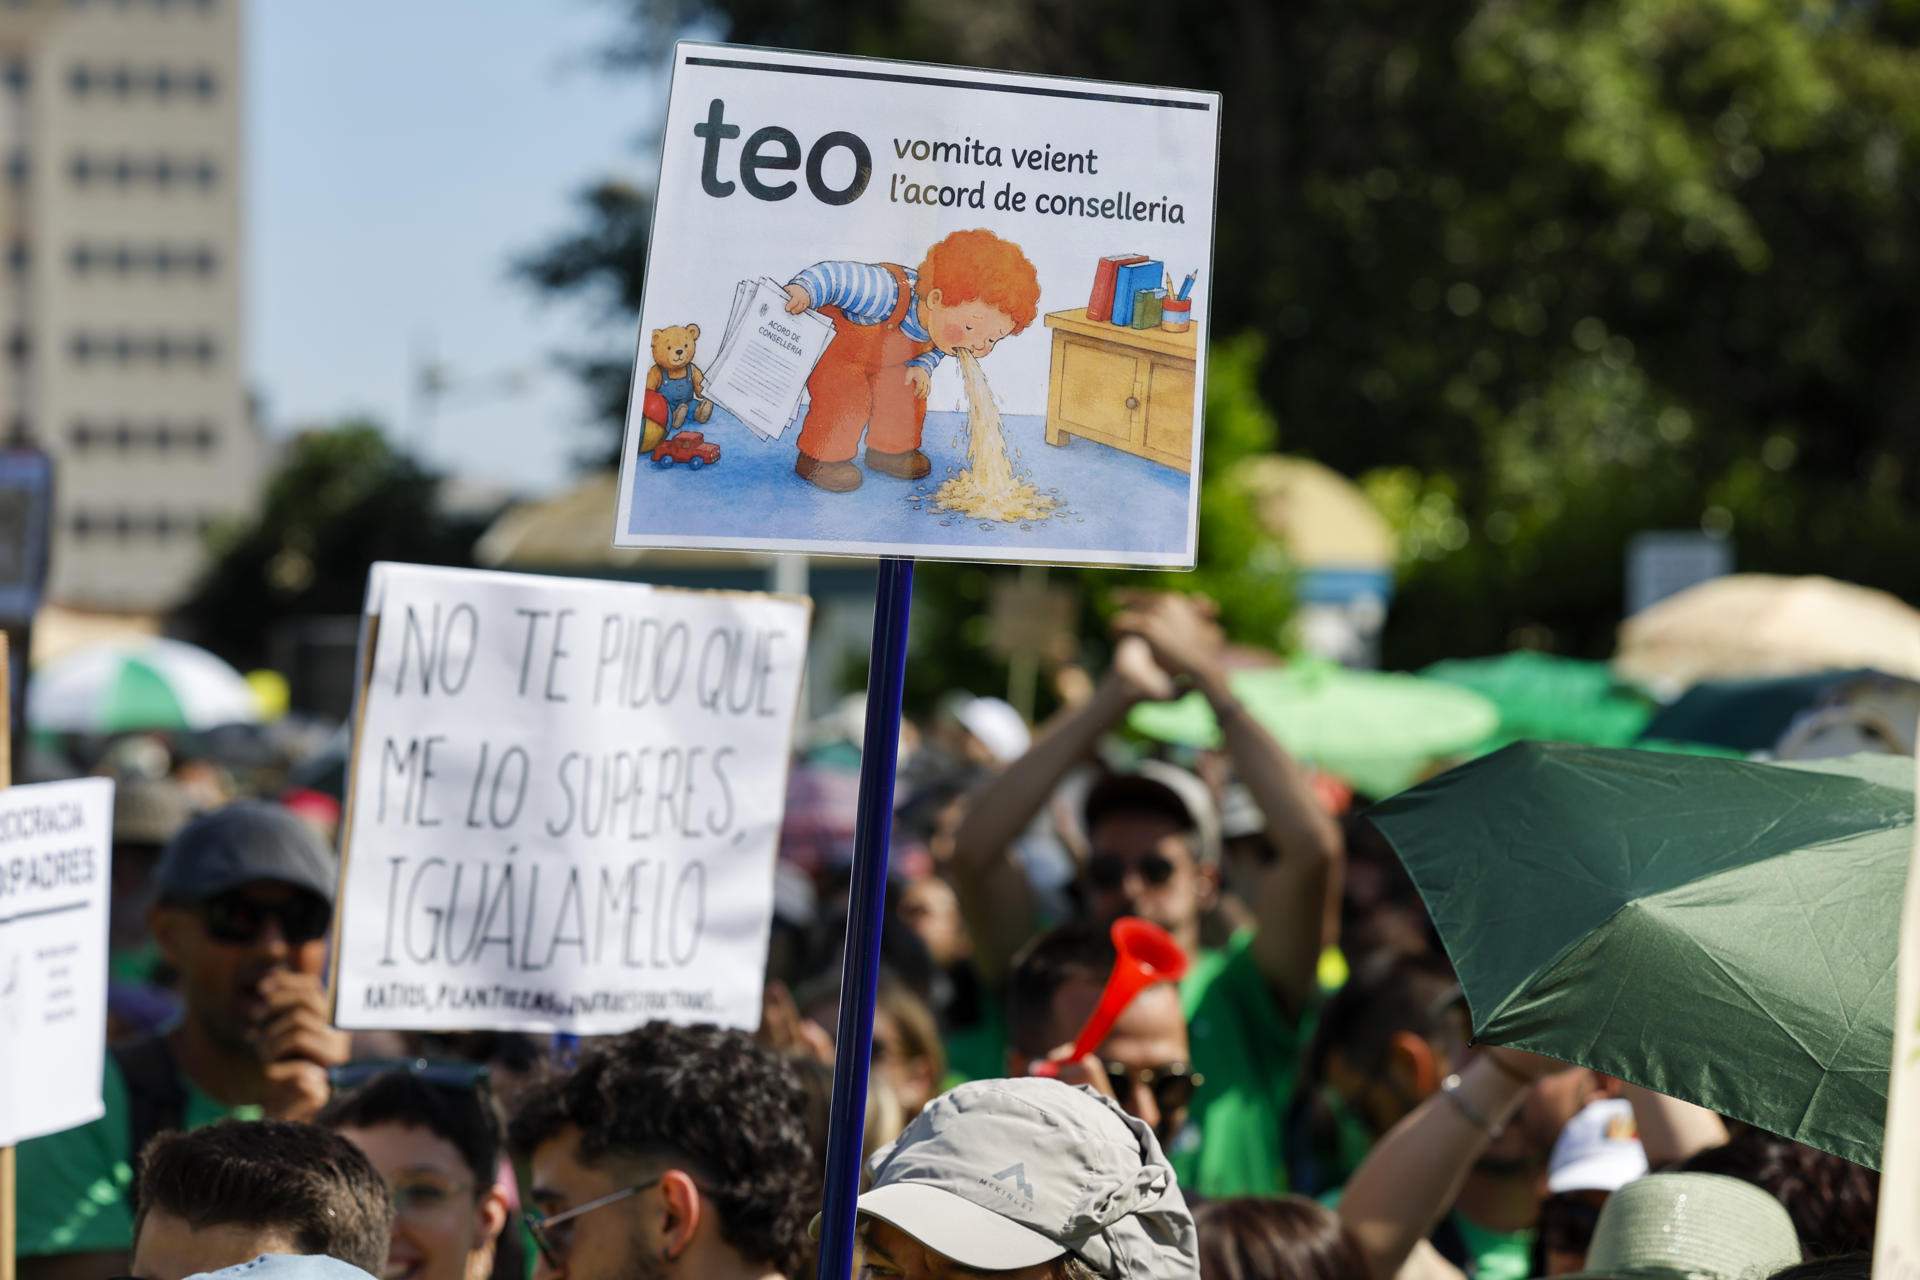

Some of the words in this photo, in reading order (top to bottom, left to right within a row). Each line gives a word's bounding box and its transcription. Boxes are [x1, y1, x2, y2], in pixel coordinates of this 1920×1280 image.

[693, 98, 873, 207] teo
[890, 173, 986, 210] l'acord
[993, 182, 1027, 213] de
[1035, 190, 1186, 225] conselleria
[893, 136, 1003, 168] vomita
[1011, 143, 1099, 175] veient
[768, 320, 791, 338] ACORD
[791, 333, 802, 343] DE
[395, 602, 479, 698] NO
[514, 608, 576, 703] TE
[593, 613, 692, 707] PIDO
[697, 626, 787, 717] QUE
[378, 736, 446, 826] ME
[466, 742, 530, 830] LO
[545, 746, 746, 846] SUPERES,
[378, 844, 707, 972] IGUÁLAMELO
